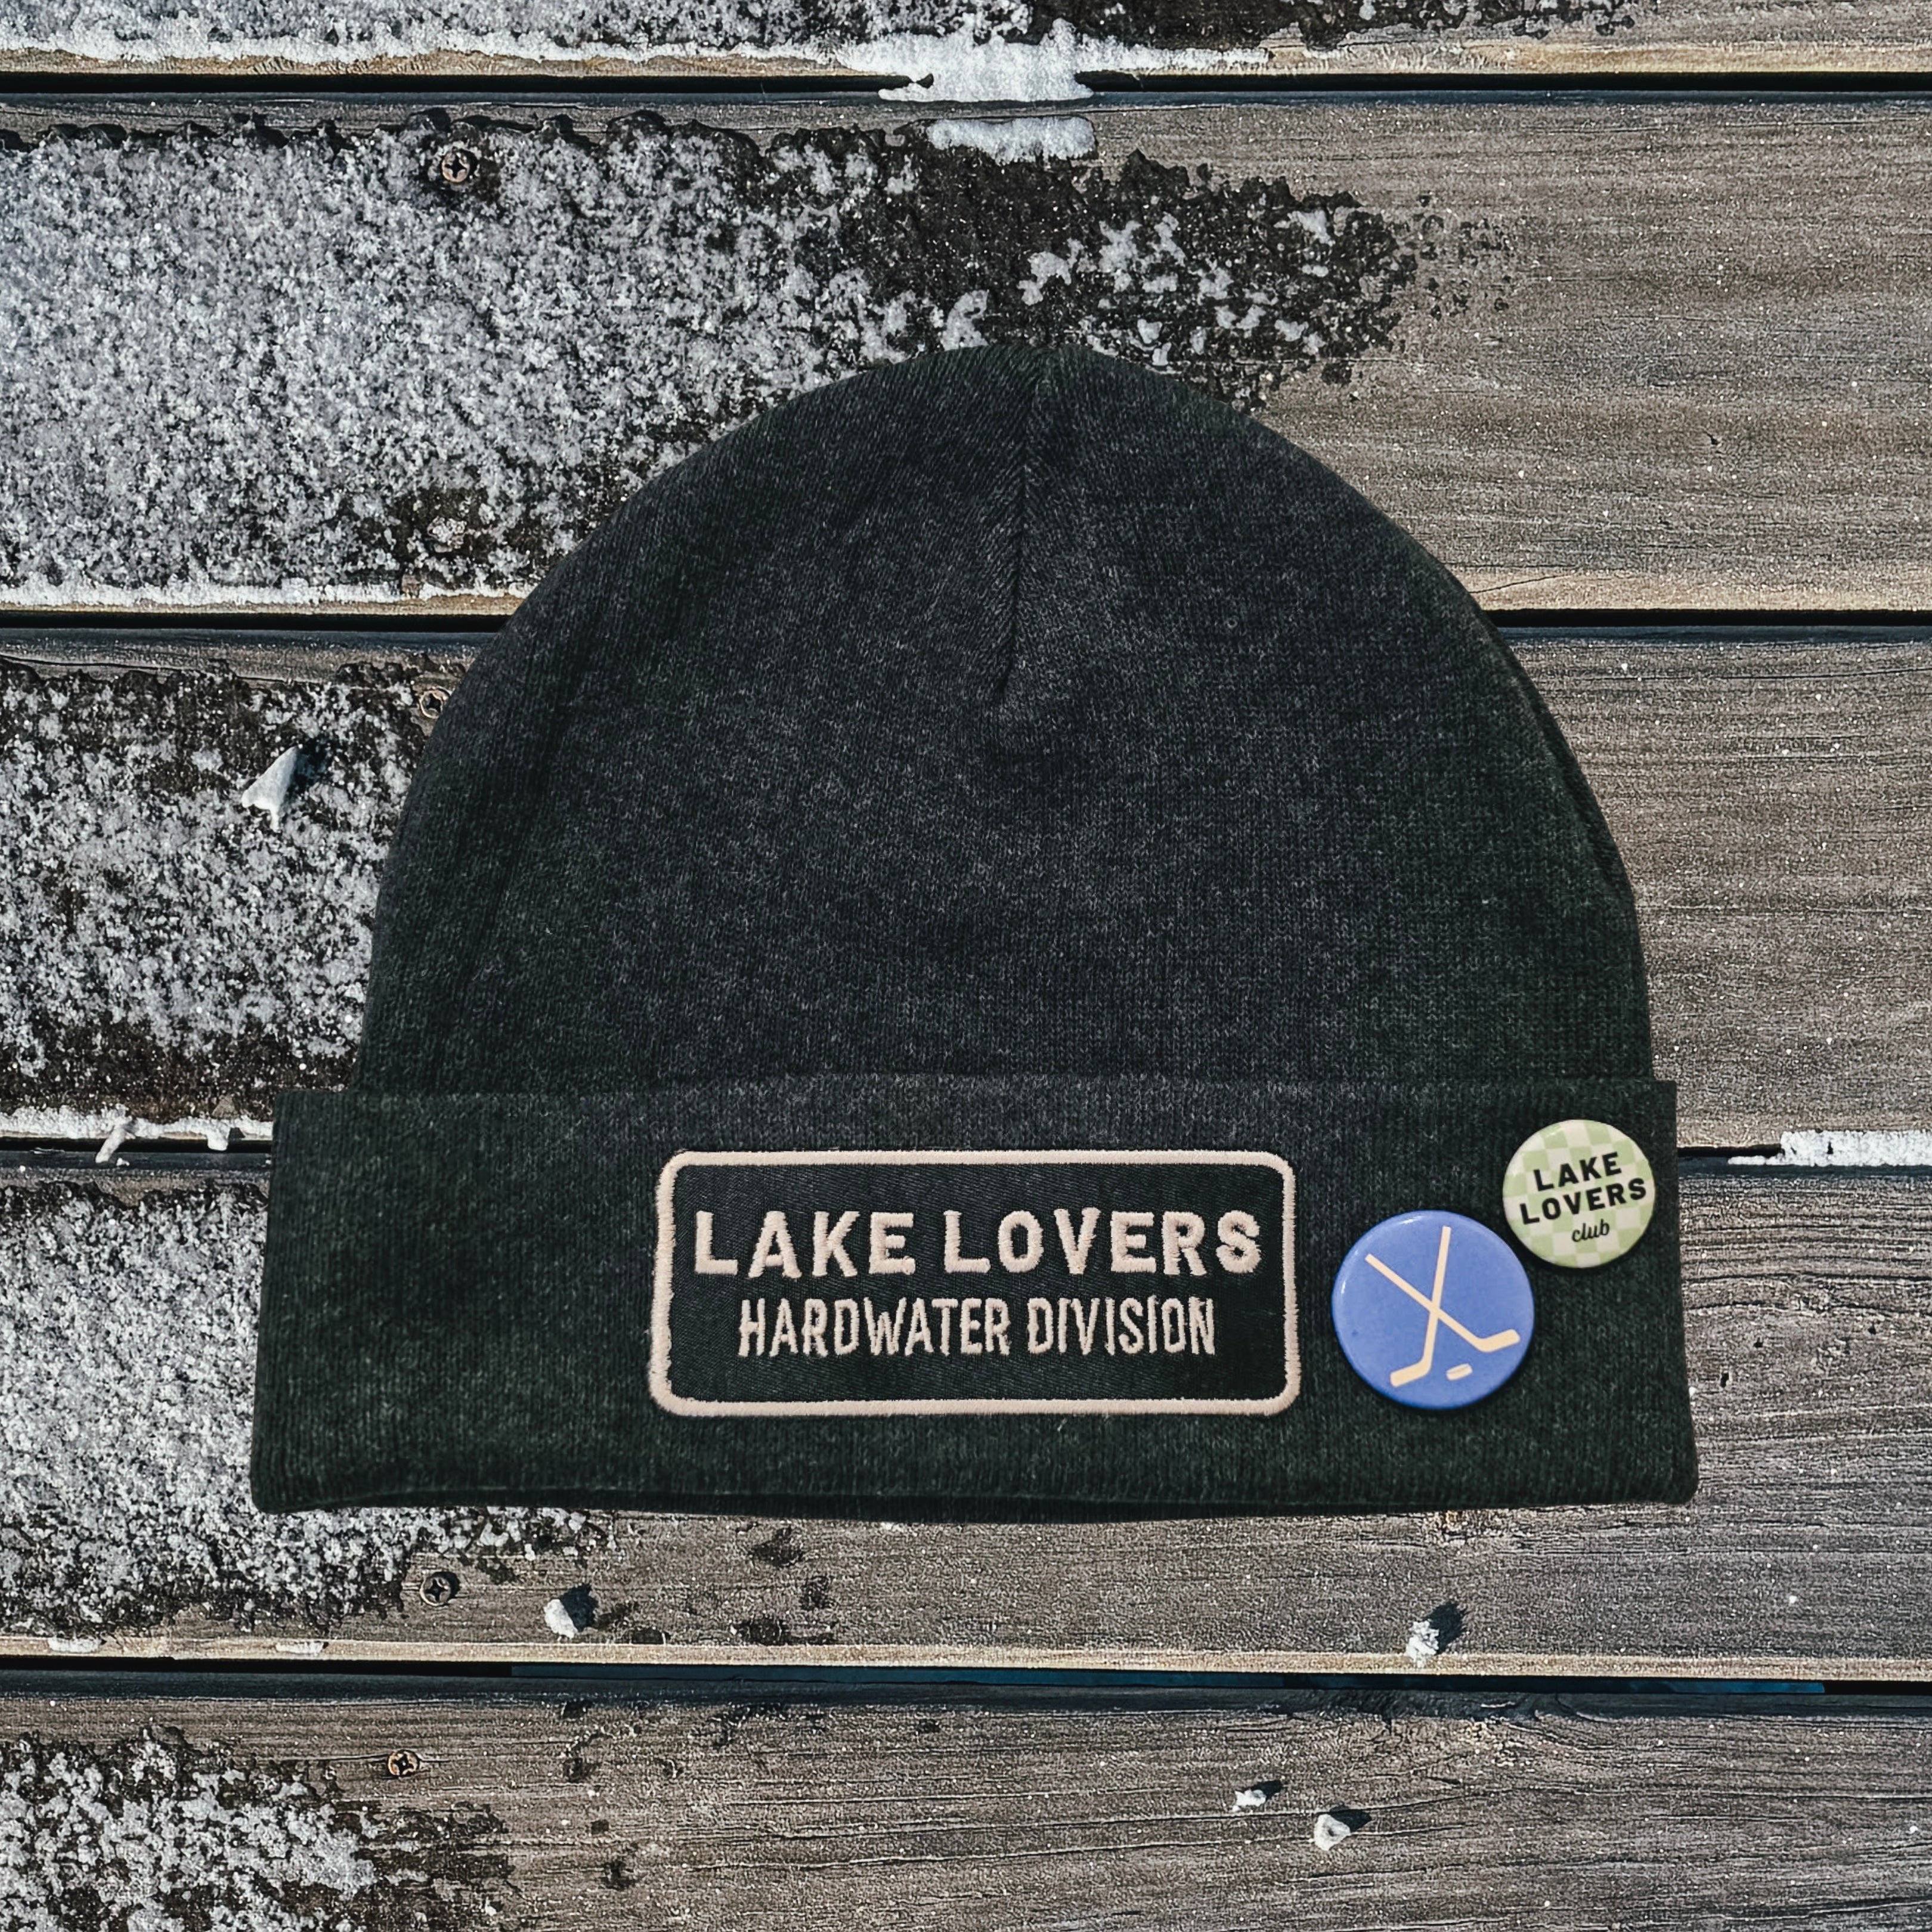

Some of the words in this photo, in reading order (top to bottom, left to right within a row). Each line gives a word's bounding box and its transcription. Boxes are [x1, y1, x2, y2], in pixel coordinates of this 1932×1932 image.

[1534, 1152, 1622, 1191] LAKE
[1520, 1178, 1646, 1224] LOVERS
[695, 1210, 915, 1277] LAKE
[944, 1208, 1264, 1276] LOVERS
[1571, 1219, 1610, 1243] club
[738, 1297, 1011, 1357] HARDWATER
[1027, 1295, 1215, 1357] DIVISION
